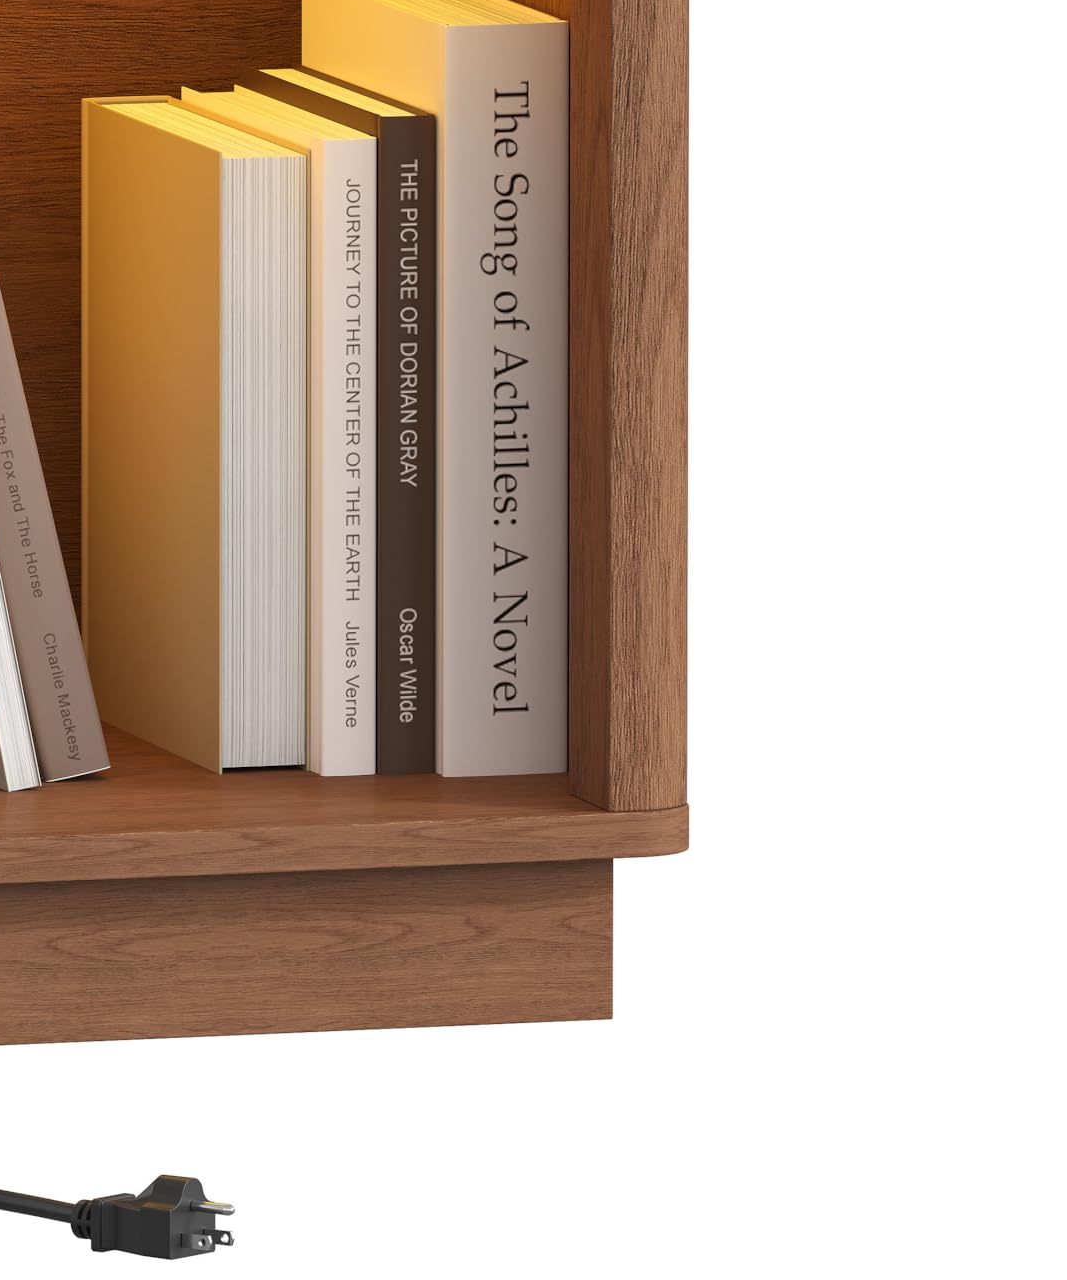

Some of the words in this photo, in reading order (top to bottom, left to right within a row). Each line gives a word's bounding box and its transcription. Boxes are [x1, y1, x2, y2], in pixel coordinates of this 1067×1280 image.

[493, 79, 531, 159] The
[399, 158, 419, 202] THE
[345, 178, 361, 276] JOURNEY
[479, 172, 531, 277] Song
[399, 207, 419, 301] PICTURE
[345, 281, 361, 309] TO
[399, 306, 419, 336] OF
[493, 290, 531, 332] of
[345, 314, 361, 356] THE
[345, 361, 361, 446] CENTER
[399, 342, 419, 424] DORIAN
[399, 429, 419, 488] GRAY
[492, 345, 531, 526] Achilles:
[1, 449, 15, 480] Fox
[345, 452, 361, 479] OF
[8, 484, 26, 513] and
[345, 486, 361, 526] THE
[17, 516, 32, 548] The
[492, 541, 529, 576] A
[24, 551, 43, 599] Horse
[345, 533, 361, 601] EARTH
[345, 621, 360, 669] Jules
[399, 607, 418, 665] Oscar
[492, 590, 530, 717] Novel
[43, 632, 65, 690] Charlie
[57, 693, 82, 762] Mackesy
[345, 674, 360, 728] Verne
[399, 669, 418, 724] Wilde
